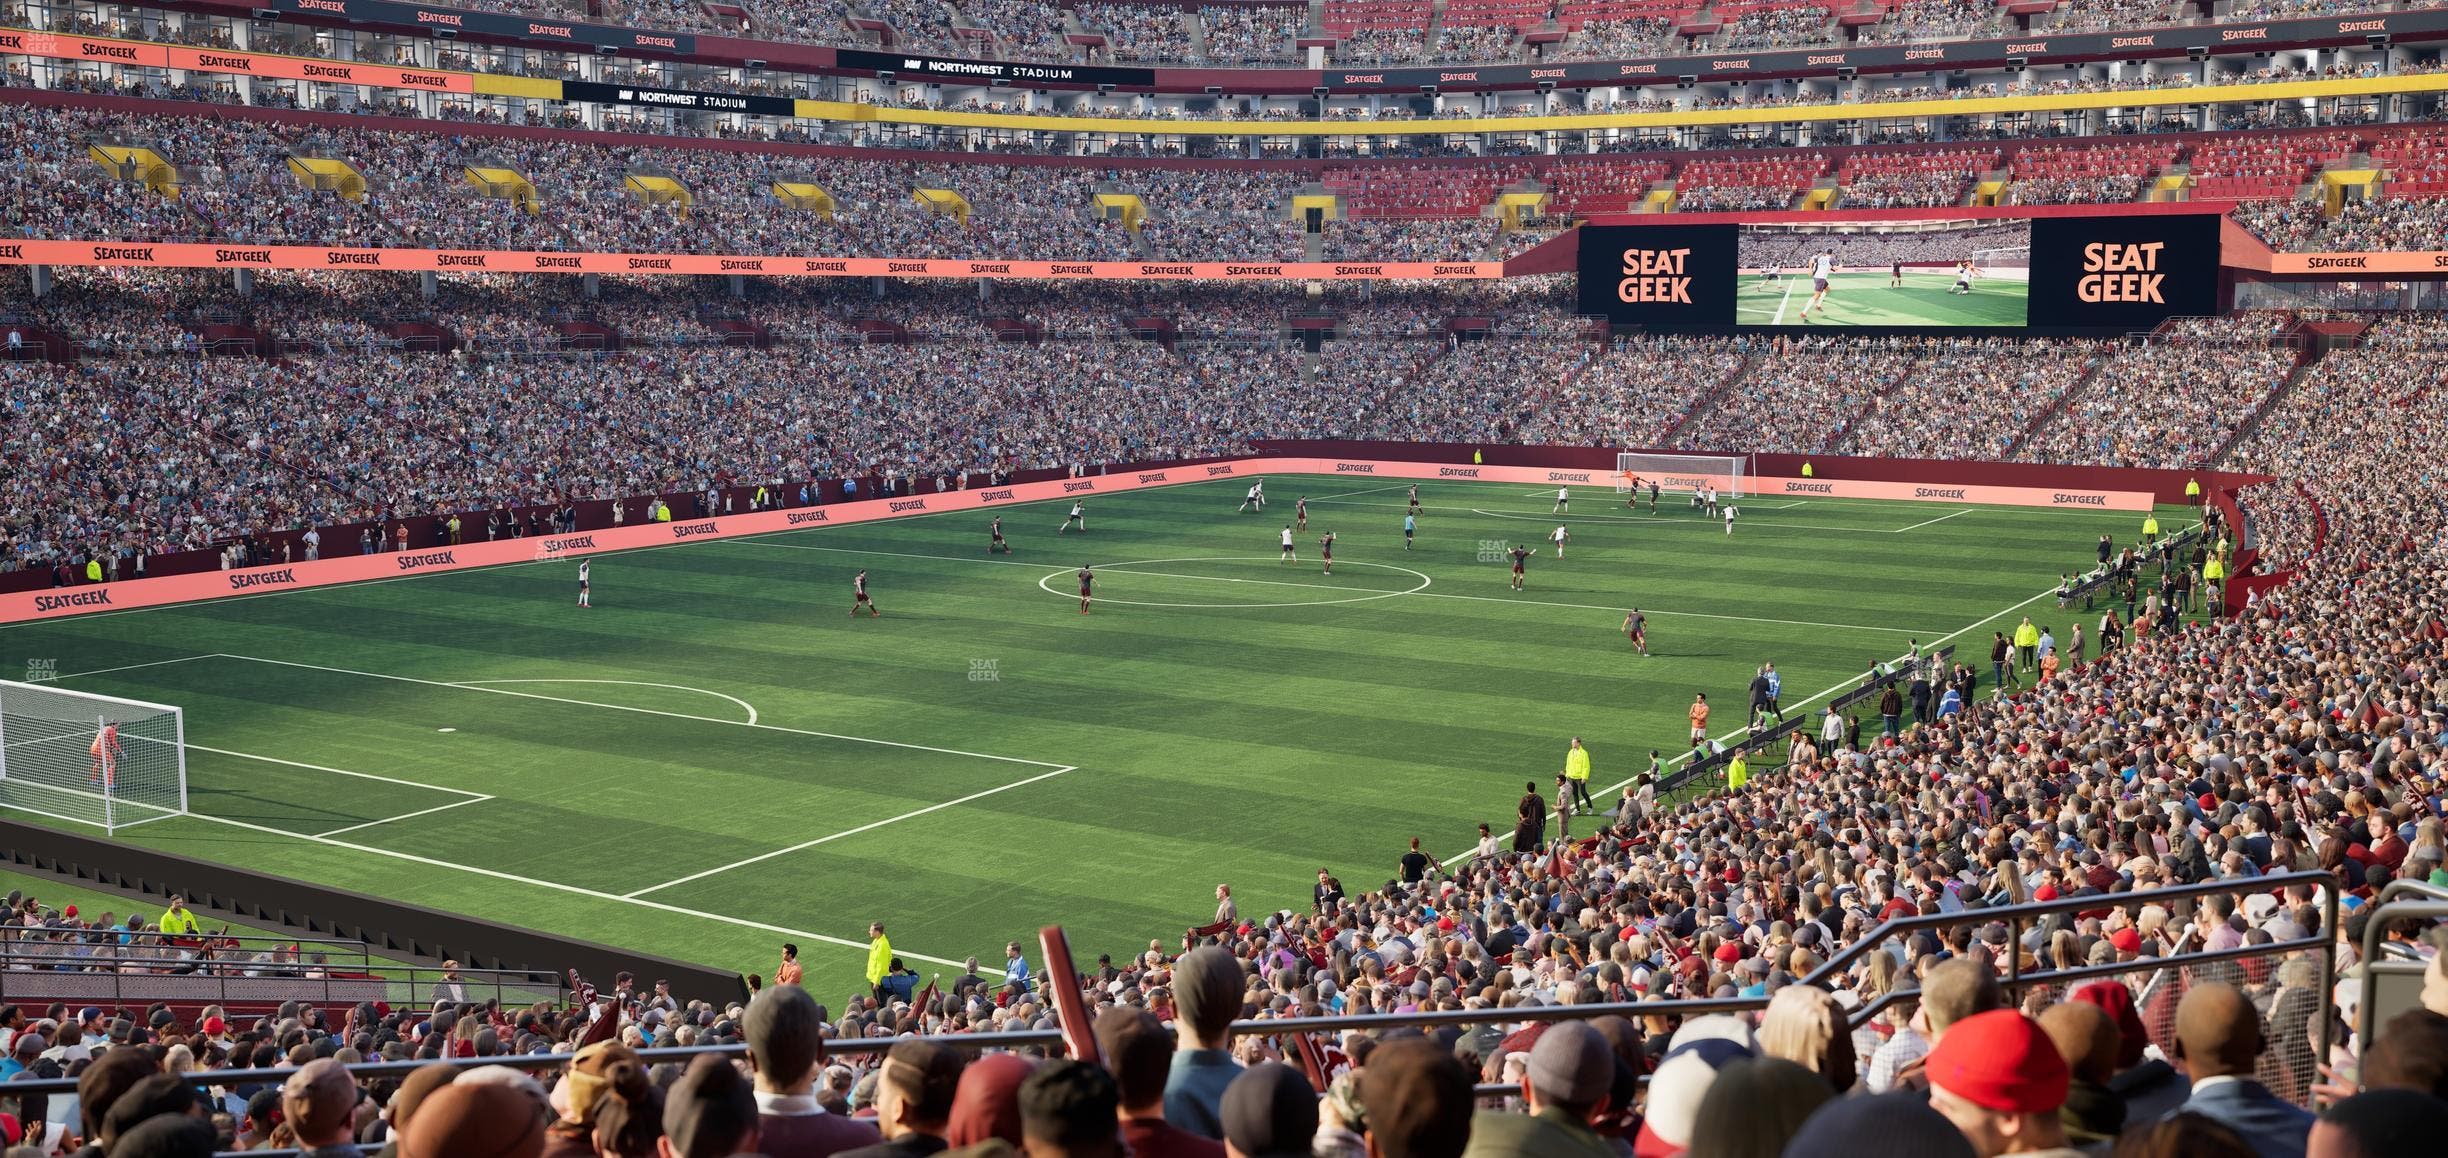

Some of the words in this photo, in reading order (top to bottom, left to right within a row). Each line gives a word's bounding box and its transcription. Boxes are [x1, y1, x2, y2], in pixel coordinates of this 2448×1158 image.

[298, 0, 346, 13] SEATGEEK
[417, 10, 463, 26] SEATGEEK
[528, 23, 572, 38] SEATGEEK
[2338, 18, 2386, 33] SEATGEEK
[2222, 27, 2267, 41] SEATGEEK
[635, 34, 676, 49] SEATGEEK
[2006, 41, 2047, 55] SEATGEEK
[2111, 35, 2154, 49] SEATGEEK
[82, 43, 137, 60] SEATGEEK
[1905, 47, 1944, 61] SEATGEEK
[198, 52, 251, 71] SEATGEEK
[1712, 59, 1750, 71] SEATGEEK
[1807, 53, 1846, 66] SEATGEEK
[303, 64, 352, 80] SEATGEEK
[928, 61, 1004, 75] NORTHWEST
[1012, 66, 1072, 79] STADIUM
[1530, 68, 1566, 79] SEATGEEK
[1620, 63, 1657, 75] SEATGEEK
[401, 73, 447, 88] SEATGEEK
[1344, 74, 1384, 84] SEATGEEK
[1440, 71, 1478, 82] SEATGEEK
[638, 91, 697, 106] NORTHWEST
[703, 96, 747, 109] STADIUM
[93, 246, 154, 262] SEATGEEK
[215, 249, 272, 264] SEATGEEK
[327, 251, 381, 266] SEATGEEK
[437, 254, 486, 267] SEATGEEK
[2084, 242, 2164, 272] SEAT
[535, 255, 582, 269] SEATGEEK
[628, 257, 672, 270] SEATGEEK
[720, 259, 763, 272] SEATGEEK
[805, 260, 847, 273] SEATGEEK
[888, 262, 928, 274] SEATGEEK
[970, 263, 1010, 274] SEATGEEK
[1623, 249, 1690, 275] SEAT
[2307, 256, 2367, 269] SEATGEEK
[1050, 264, 1094, 275] SEATGEEK
[1141, 265, 1194, 276] SEATGEEK
[1225, 265, 1282, 276] SEATGEEK
[1335, 265, 1383, 276] SEATGEEK
[1433, 265, 1476, 276] SEATGEEK
[1619, 277, 1691, 303] GEEK
[2078, 274, 2164, 303] GEEK
[1206, 464, 1234, 476] SEATGEEK
[1335, 462, 1375, 474] SEATGEEK
[1439, 467, 1480, 478] SEATGEEK
[1138, 471, 1167, 485] SEATGEEK
[1547, 471, 1591, 483] SEATGEEK
[1063, 480, 1095, 493] SEATGEEK
[1785, 481, 1833, 494] SEATGEEK
[1914, 487, 1965, 500] SEATGEEK
[980, 488, 1015, 503] SEATGEEK
[2052, 493, 2106, 506] SEATGEEK
[889, 498, 927, 513] SEATGEEK
[786, 509, 829, 525] SEATGEEK
[672, 521, 720, 538] SEATGEEK
[543, 535, 596, 553] SEATGEEK
[397, 550, 457, 570] SEATGEEK
[229, 568, 297, 590] SEATGEEK
[34, 588, 113, 612] SEATGEEK
